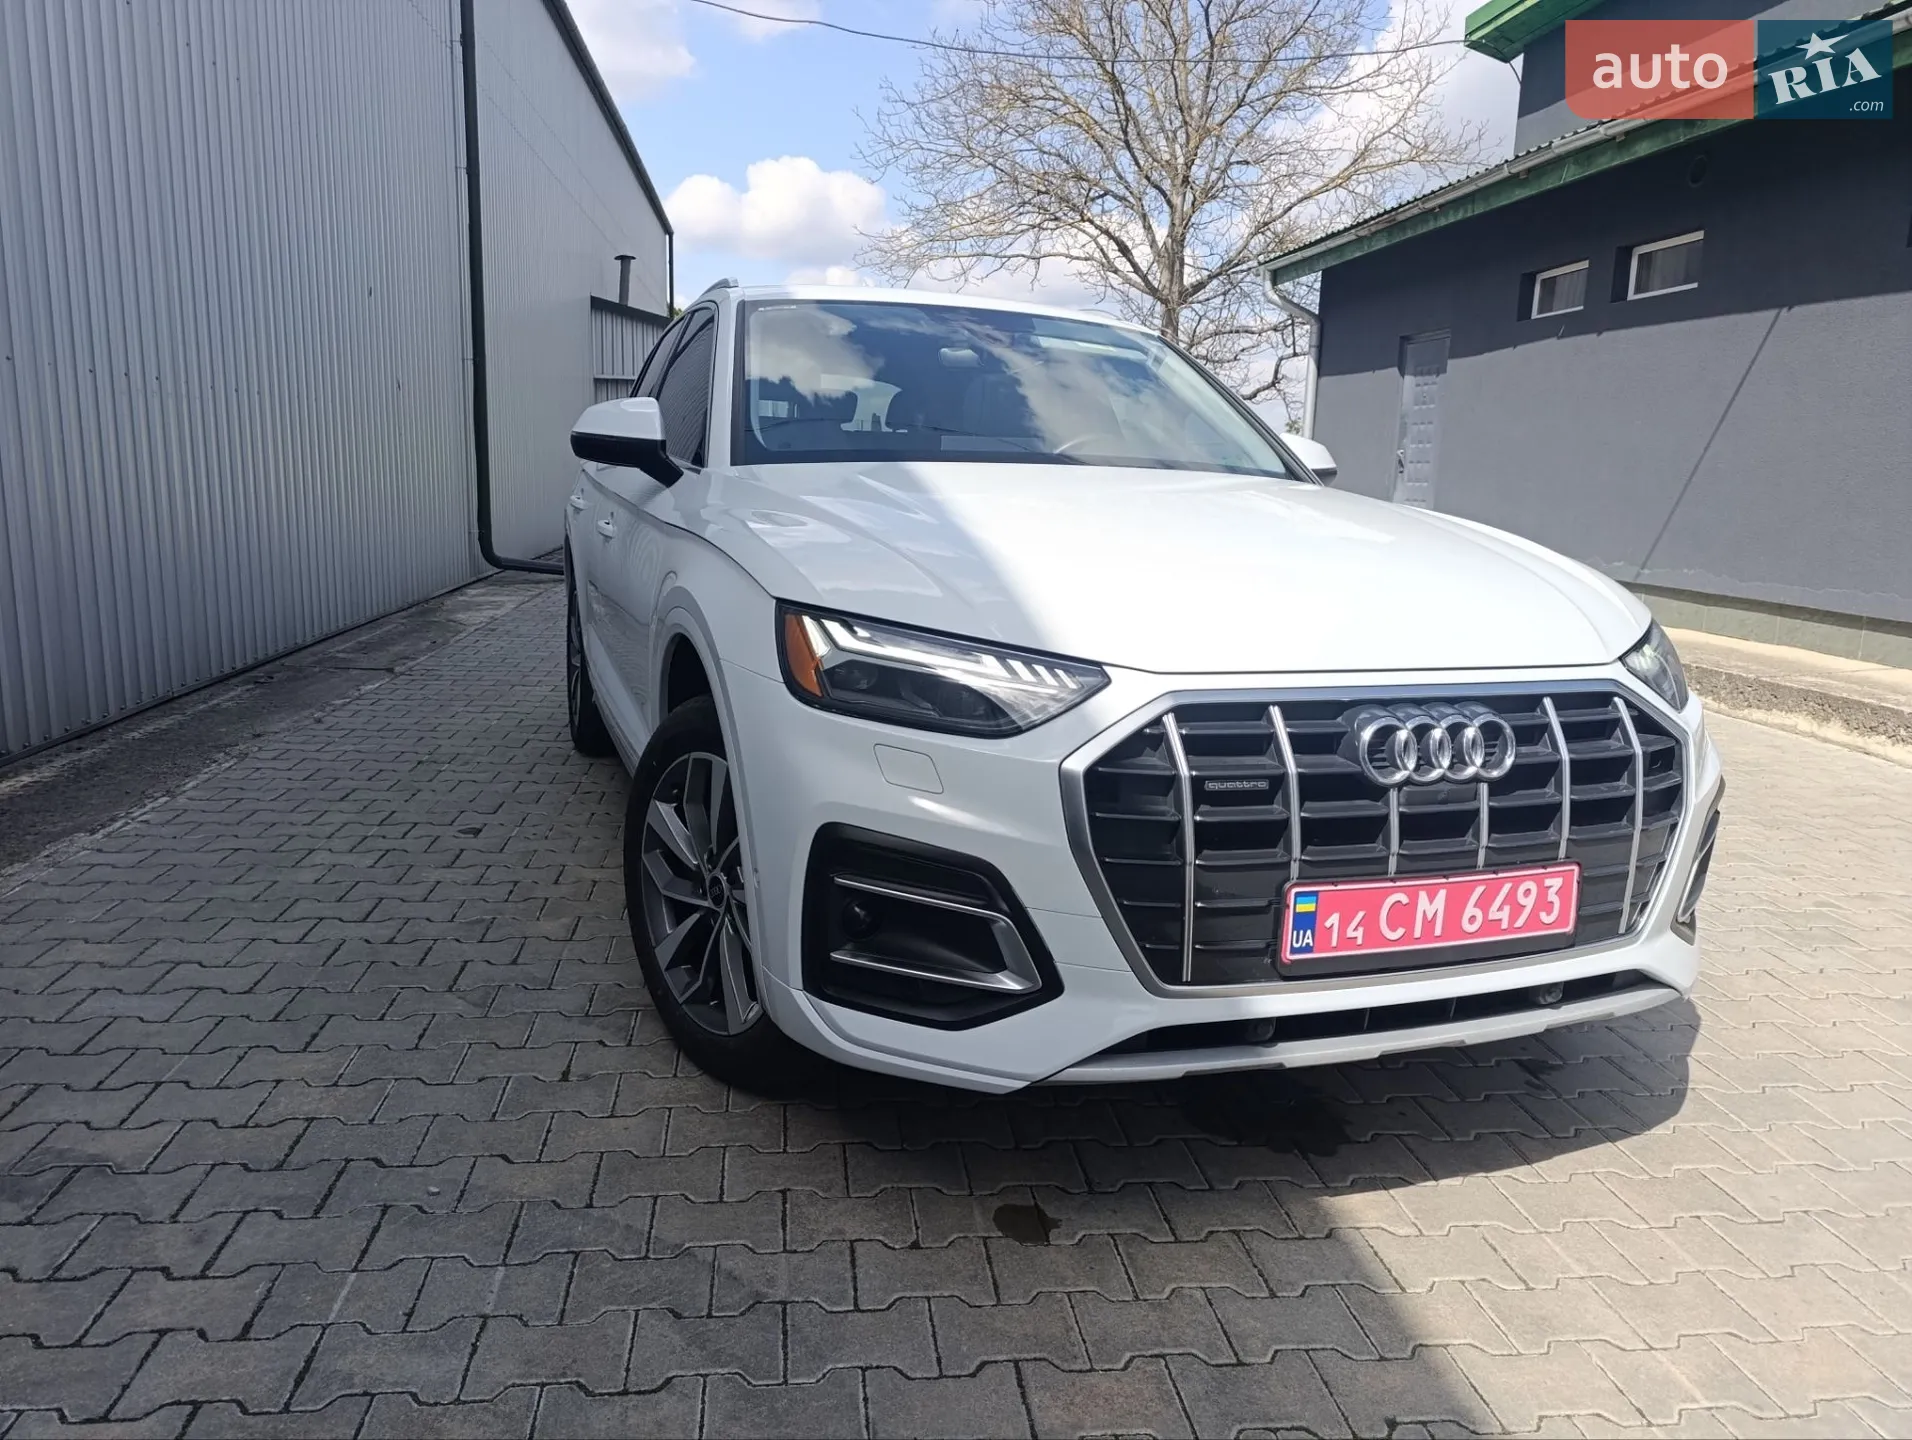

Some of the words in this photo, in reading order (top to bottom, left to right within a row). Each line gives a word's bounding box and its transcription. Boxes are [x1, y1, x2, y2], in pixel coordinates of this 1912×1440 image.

[1208, 780, 1267, 790] quattro
[1324, 911, 1367, 947] 14
[1379, 888, 1447, 941] CM
[1461, 876, 1564, 934] 6493
[1292, 929, 1314, 948] UA
